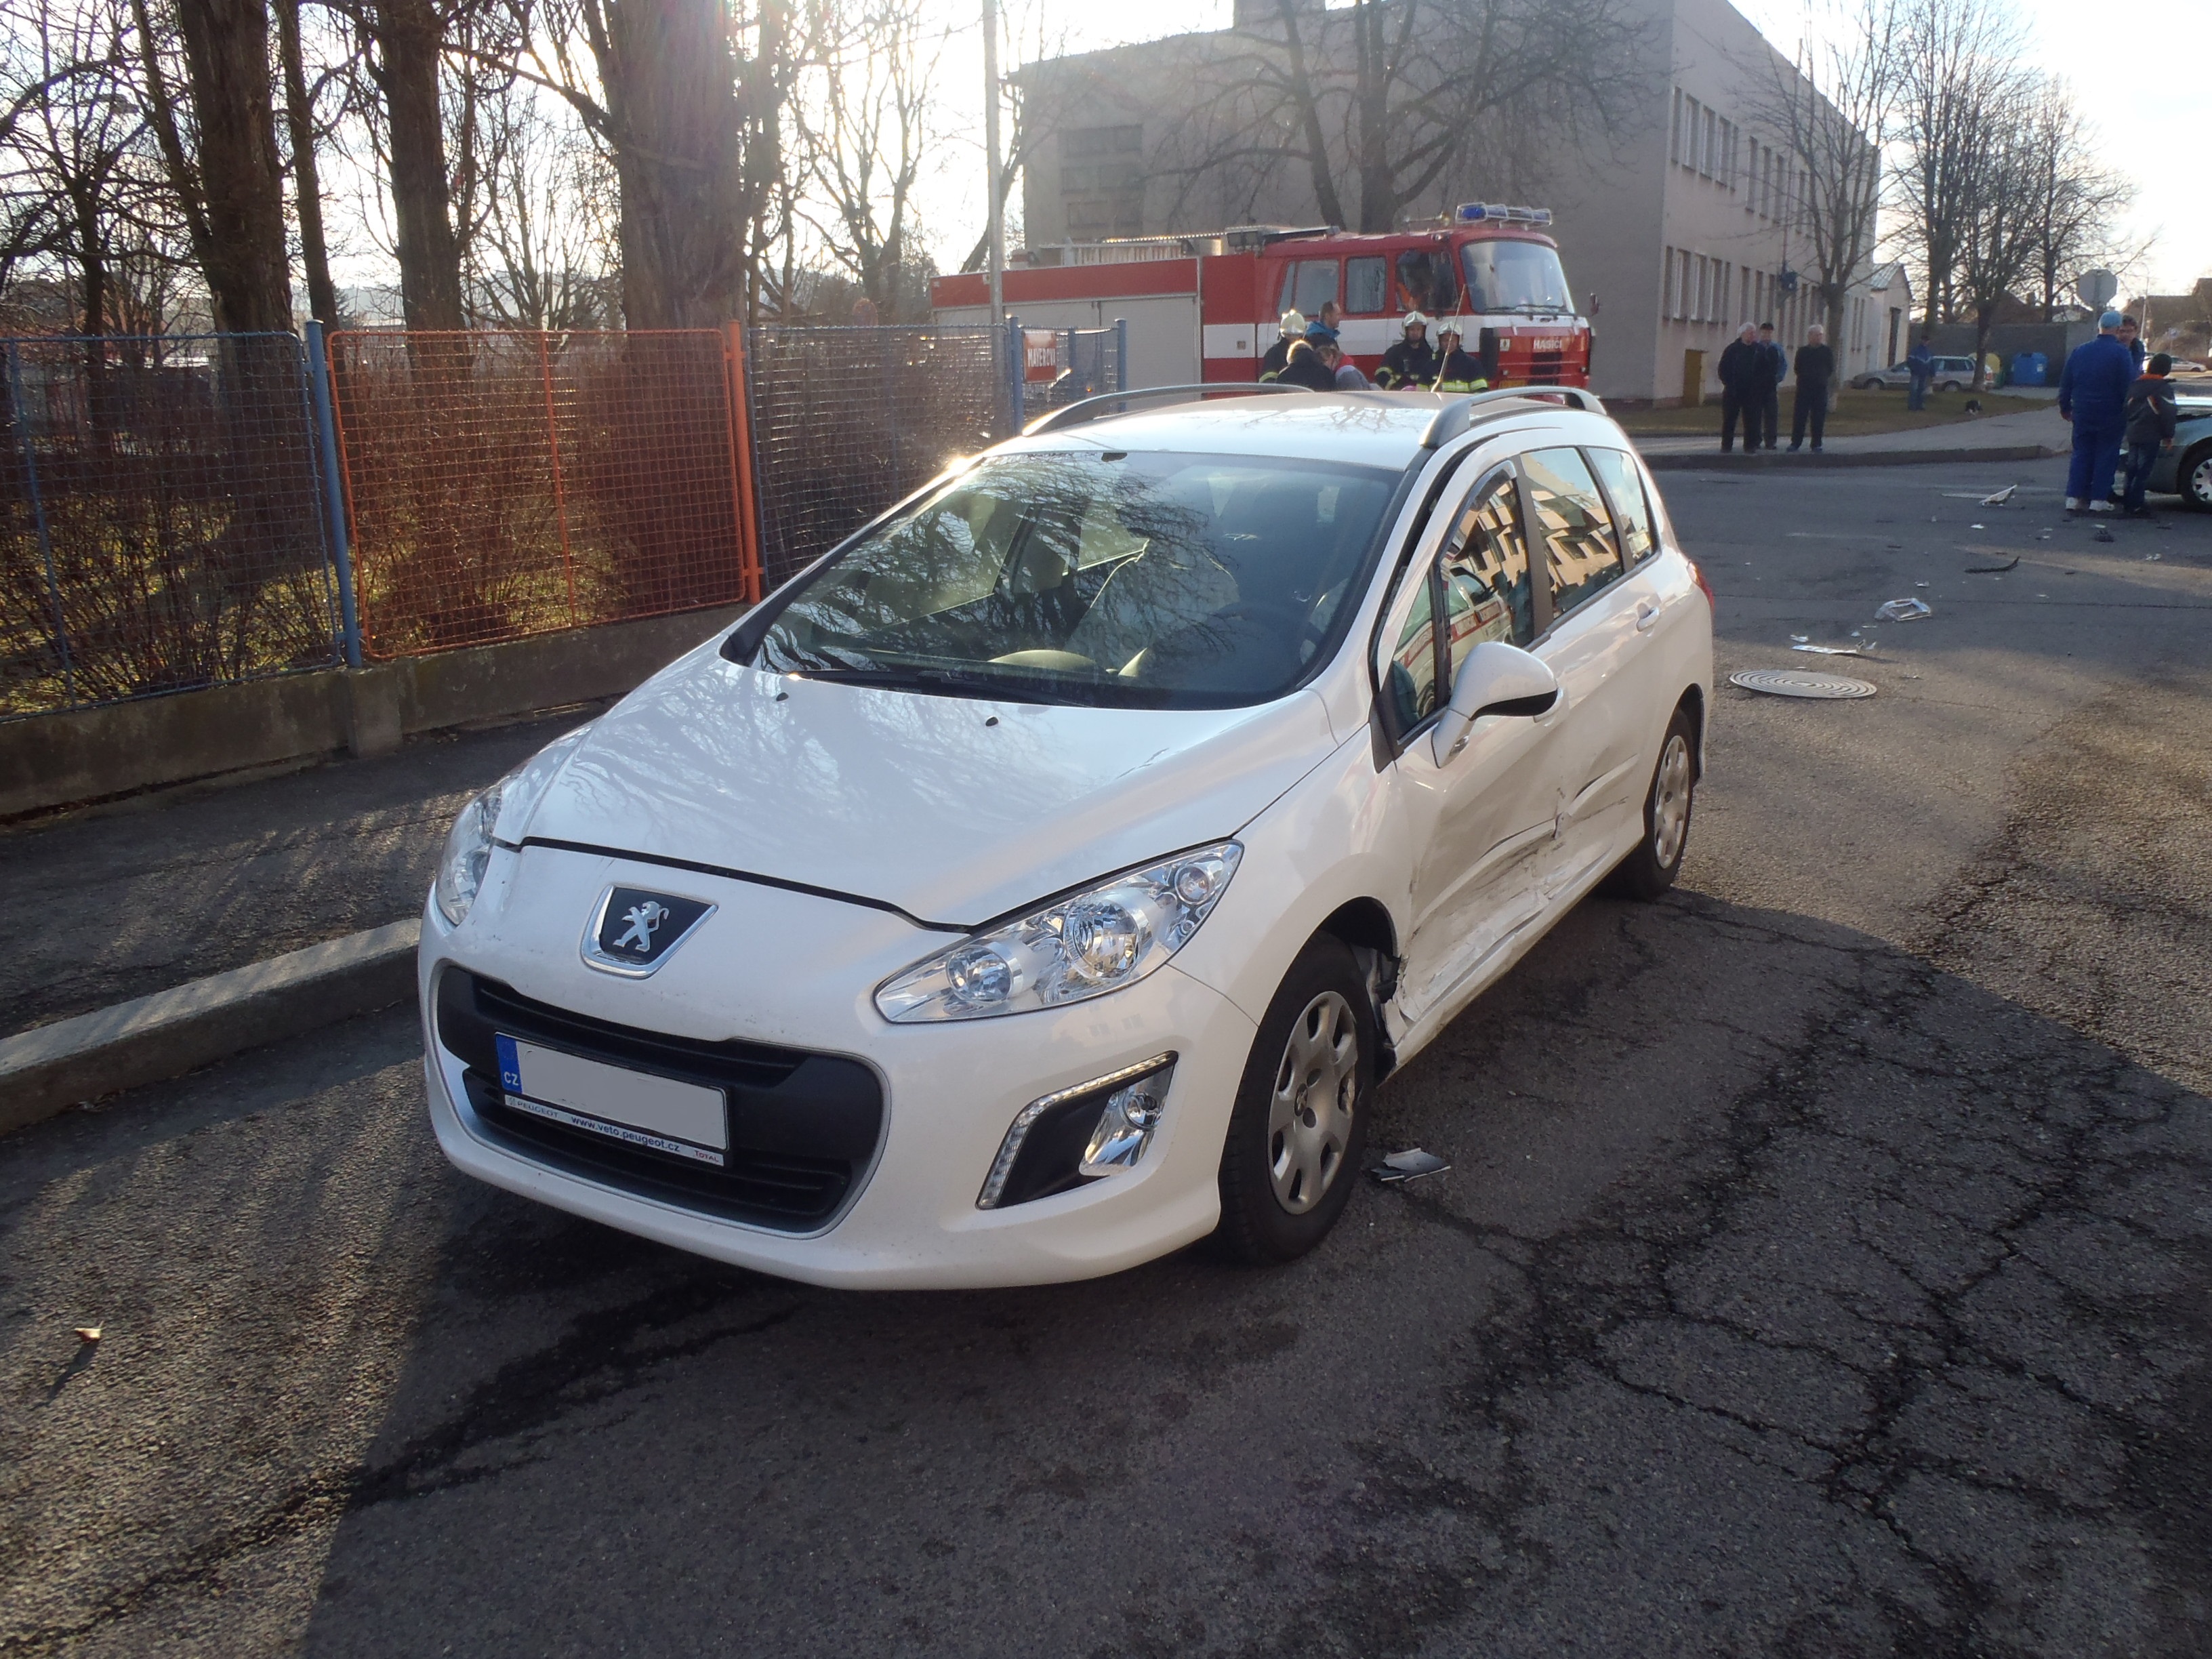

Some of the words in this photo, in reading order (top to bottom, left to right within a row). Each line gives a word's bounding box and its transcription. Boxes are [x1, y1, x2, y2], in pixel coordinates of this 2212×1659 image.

[504, 1071, 519, 1086] CZ
[517, 1101, 558, 1118] PEUGEOT
[571, 1115, 680, 1152] www.veto.peugeot.cz
